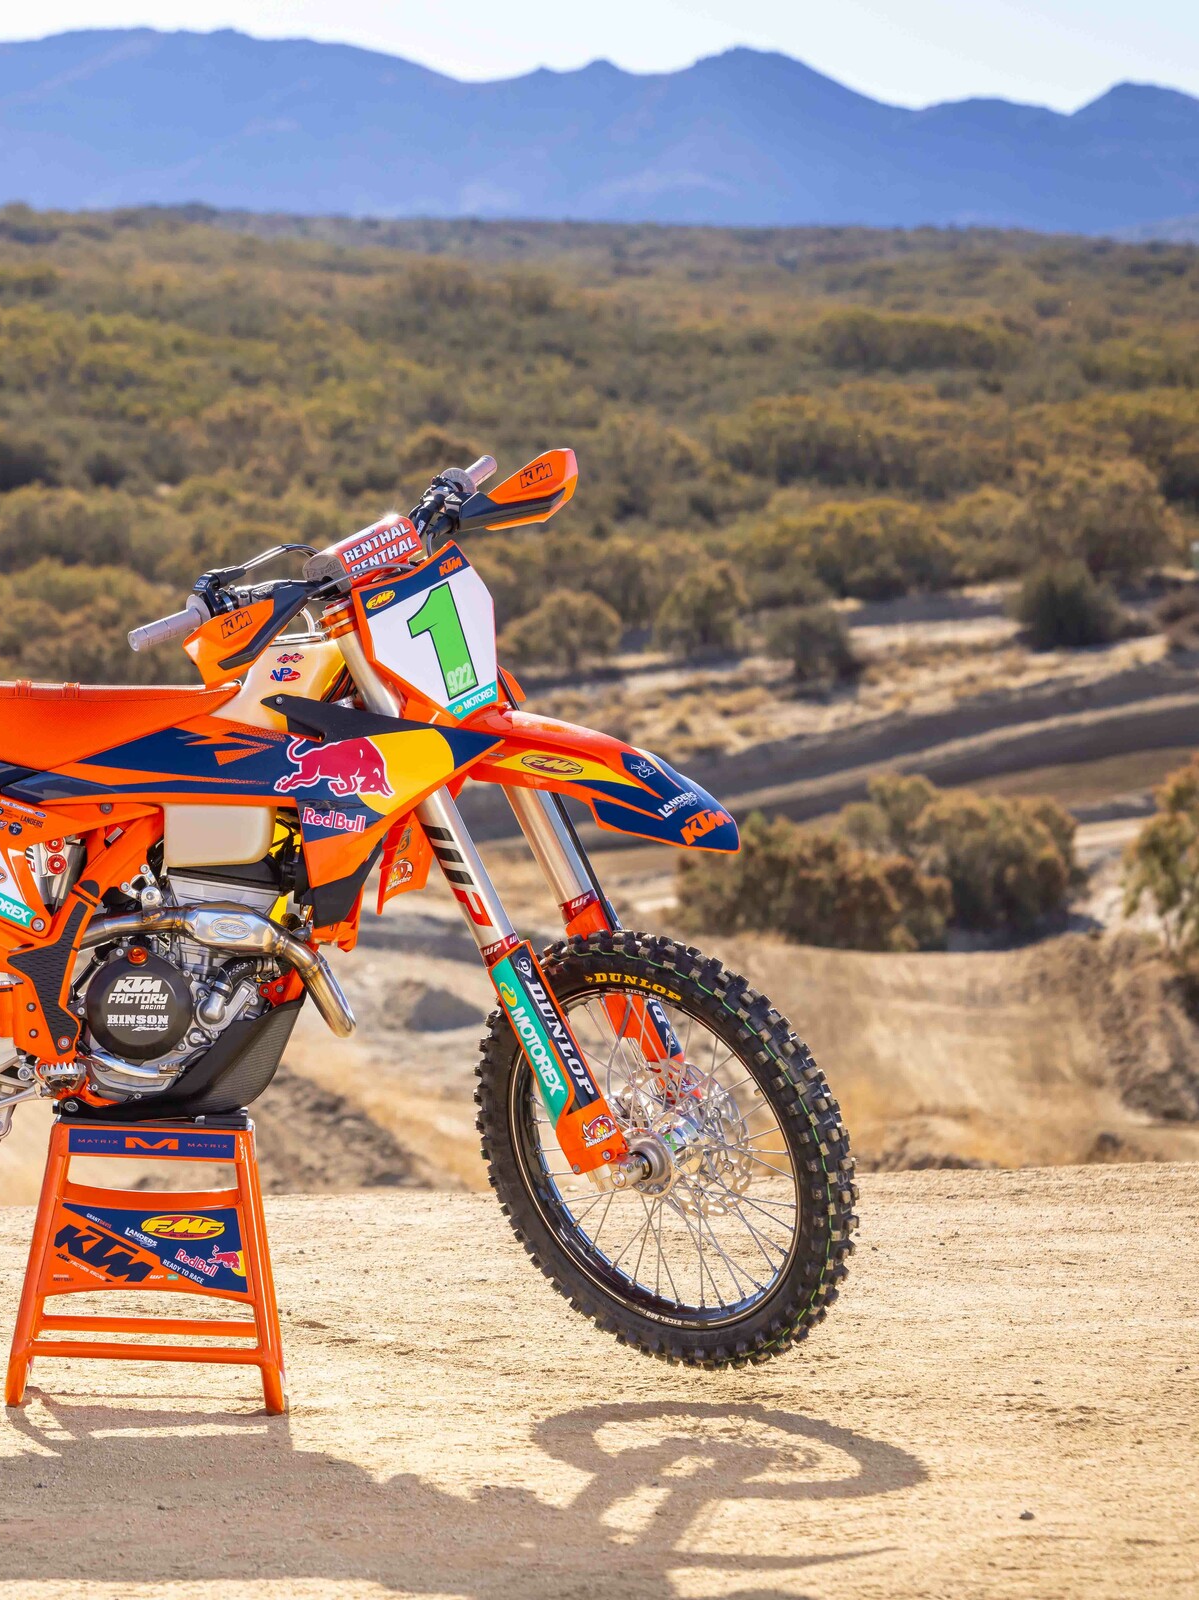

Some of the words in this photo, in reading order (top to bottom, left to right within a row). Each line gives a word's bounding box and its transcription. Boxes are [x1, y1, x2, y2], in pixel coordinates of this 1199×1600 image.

[519, 462, 553, 489] KTM
[342, 521, 411, 564] RENTHAL
[439, 556, 463, 577] KTM
[367, 590, 395, 608] FMF
[221, 611, 253, 639] KTM
[407, 581, 479, 701] 1
[272, 667, 293, 682] VP
[446, 662, 474, 693] 922
[464, 686, 496, 709] MOTOREX
[522, 757, 583, 772] FMF
[657, 791, 697, 818] LANDERS
[20, 815, 44, 828] LANDERS
[303, 807, 336, 828] Red
[335, 811, 367, 833] Bull
[680, 809, 732, 845] KTM
[483, 942, 502, 957] WP
[113, 976, 162, 992] KTM
[594, 972, 682, 1001] DUNLOP
[625, 988, 648, 997] EXCEL
[648, 993, 662, 1001] A60
[107, 993, 169, 1004] FACTORY
[107, 1014, 169, 1024] HINSON
[525, 981, 595, 1096] DUNLOP
[511, 1005, 565, 1097] MOTOREX
[124, 1226, 158, 1247] LANDERS
[141, 1217, 225, 1234] FMF
[54, 1224, 154, 1283] KTM
[174, 1248, 199, 1267] Red
[195, 1260, 220, 1278] Bull
[69, 1260, 90, 1273] FACTORY
[89, 1267, 107, 1281] RACING
[162, 1259, 181, 1272] READY
[181, 1267, 190, 1277] TO
[188, 1272, 205, 1285] RACE
[660, 1315, 683, 1326] EXCEL
